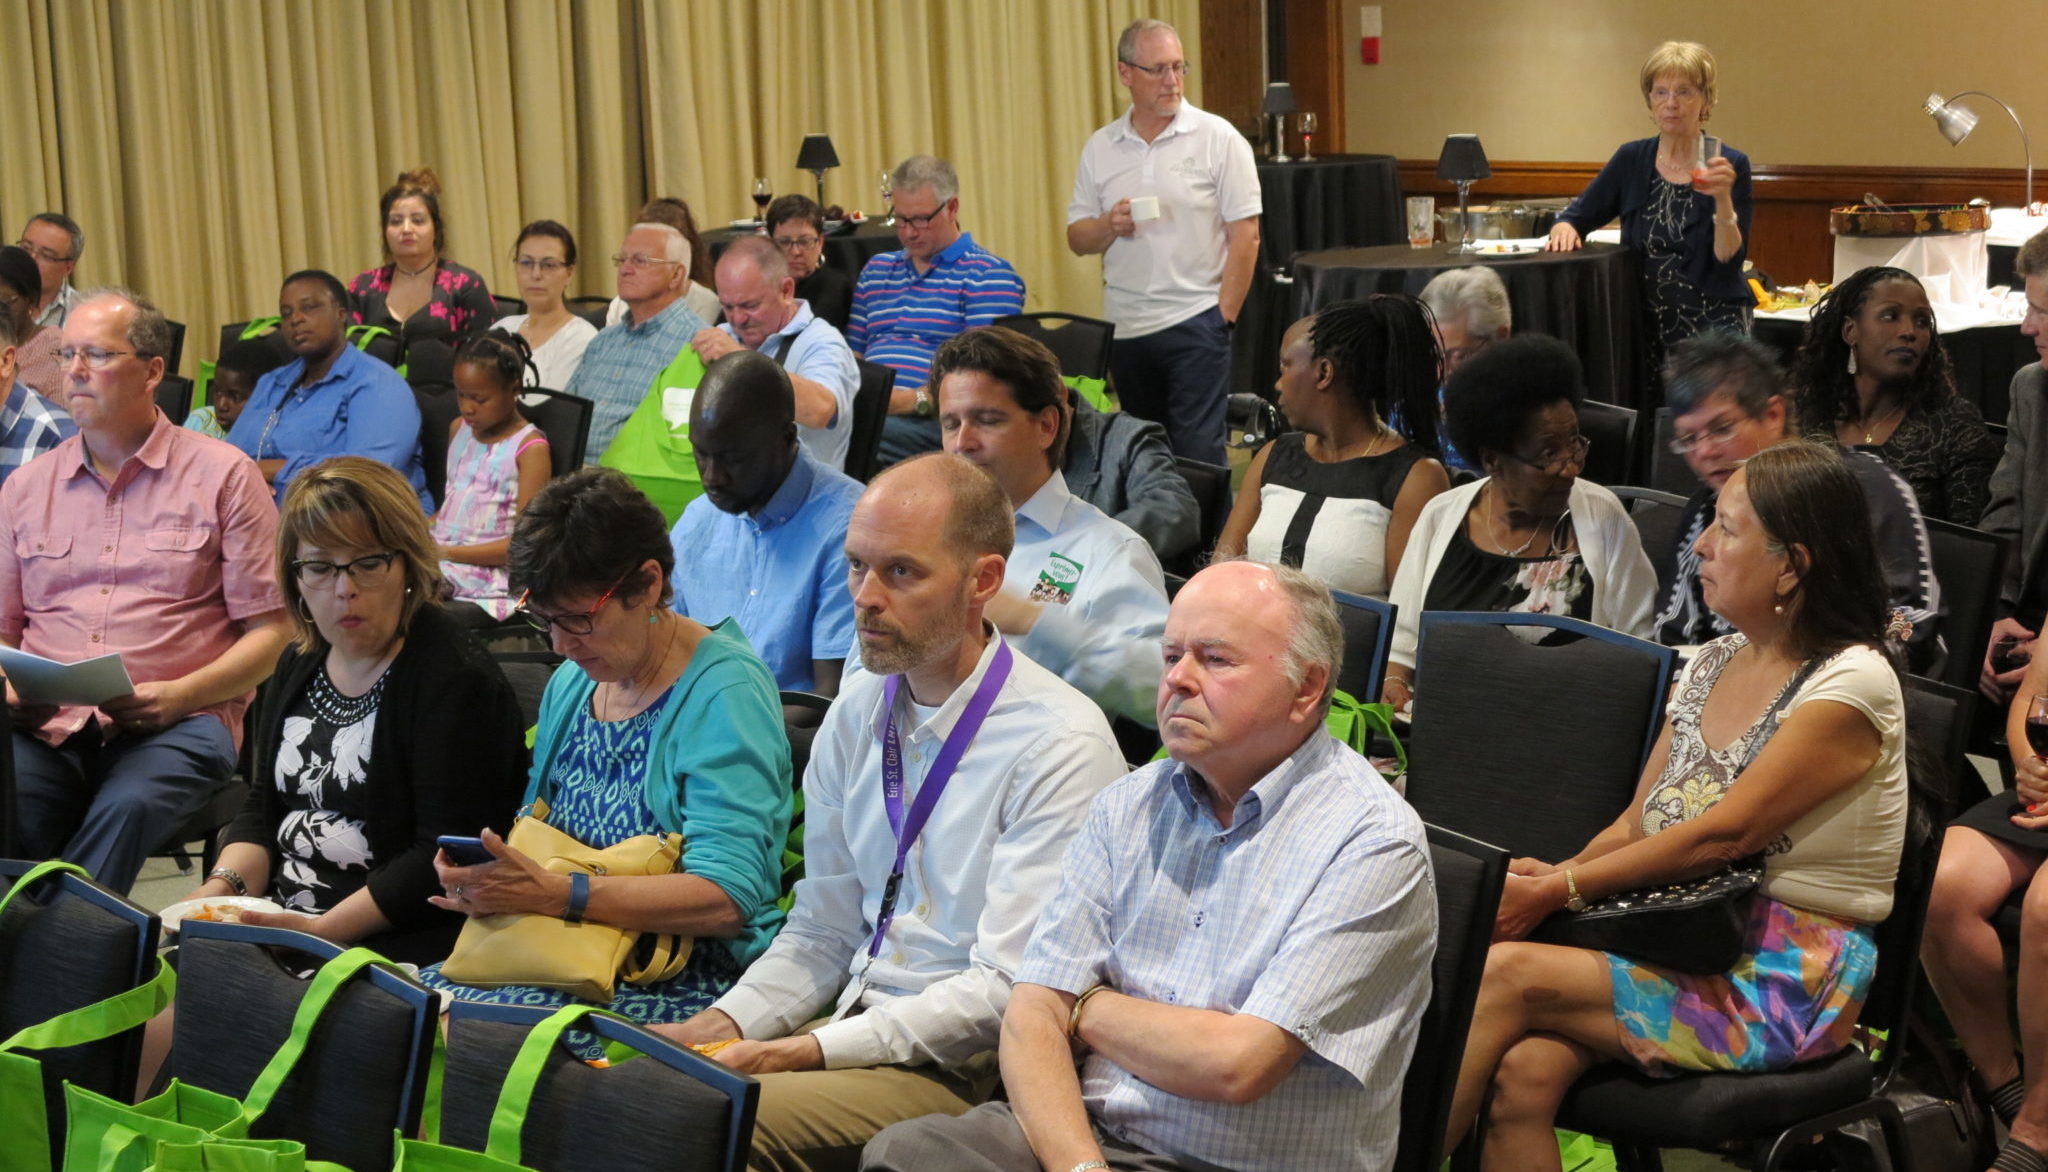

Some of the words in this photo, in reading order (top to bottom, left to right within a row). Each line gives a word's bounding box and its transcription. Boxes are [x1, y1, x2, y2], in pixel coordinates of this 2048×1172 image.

[886, 747, 898, 766] Clair
[886, 768, 898, 780] St.
[887, 782, 898, 798] Erie
